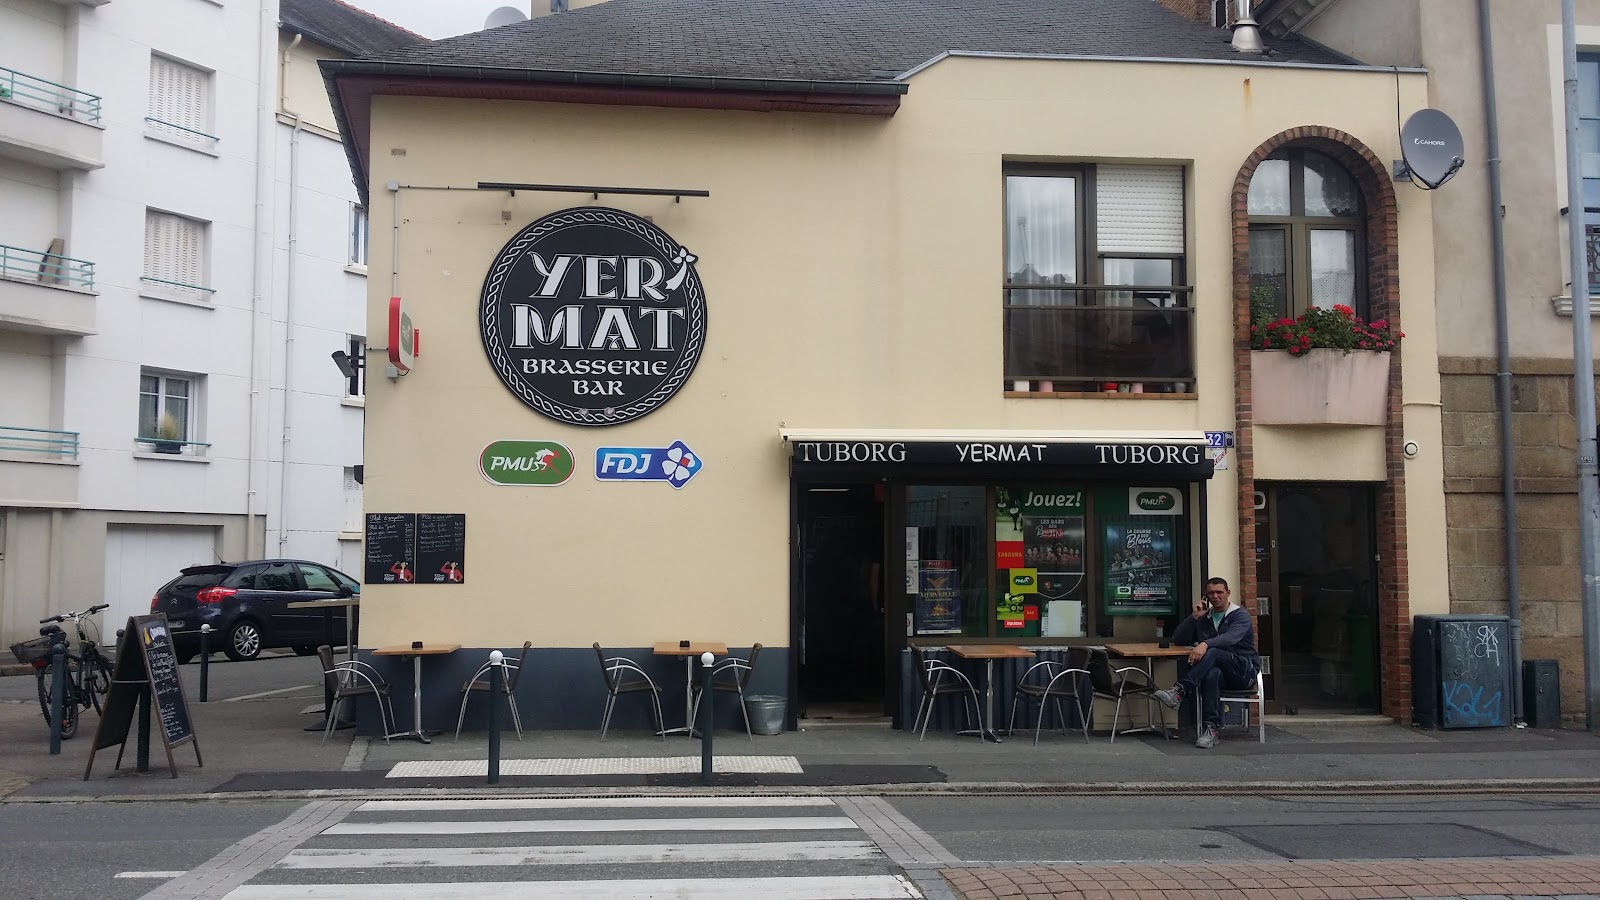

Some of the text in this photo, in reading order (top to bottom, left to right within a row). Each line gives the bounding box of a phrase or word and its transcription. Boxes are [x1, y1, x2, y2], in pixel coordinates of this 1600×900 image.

[527, 251, 670, 302] YER
[509, 303, 686, 351] MAT
[521, 358, 668, 376] BRASSERIE
[572, 379, 625, 396] BAR
[1206, 433, 1222, 446] 32
[798, 442, 908, 463] TUBORG
[955, 443, 1048, 463] YERMAT
[1094, 444, 1201, 465] TUBORG
[490, 455, 533, 472] PMU
[601, 453, 652, 474] FDJ
[1024, 491, 1082, 507] Jouez!
